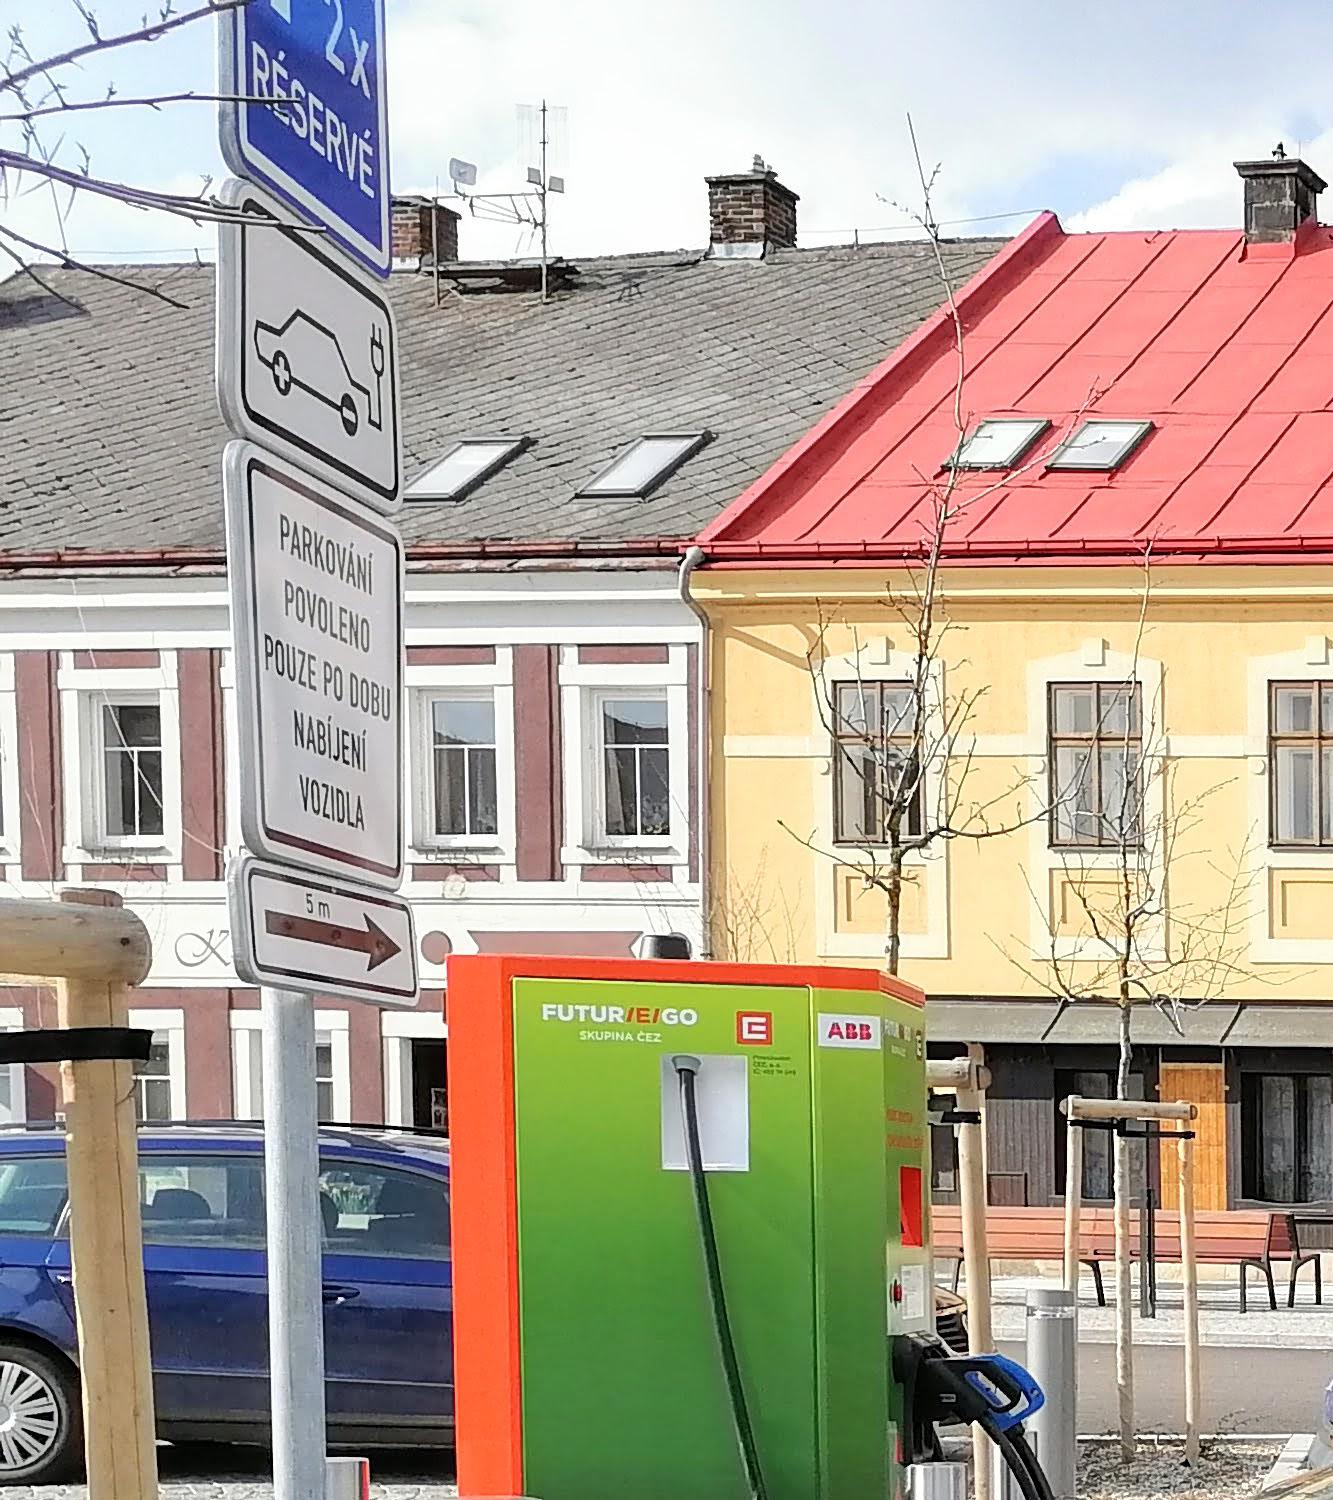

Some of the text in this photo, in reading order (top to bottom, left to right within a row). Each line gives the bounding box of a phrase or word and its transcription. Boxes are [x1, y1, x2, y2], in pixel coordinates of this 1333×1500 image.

[252, 41, 375, 199] RÉSERVÉ
[280, 513, 373, 596] PARKOVÁNÍ
[285, 579, 370, 654] POVOLENO
[264, 633, 391, 722] POUZE PO DOBU
[293, 709, 367, 773] NABÍJENÍ
[299, 774, 365, 832] VOZIDLA
[305, 893, 332, 919] 5 m
[579, 1030, 663, 1043] SKUPINA ČEZ
[828, 1022, 872, 1040] ABB
